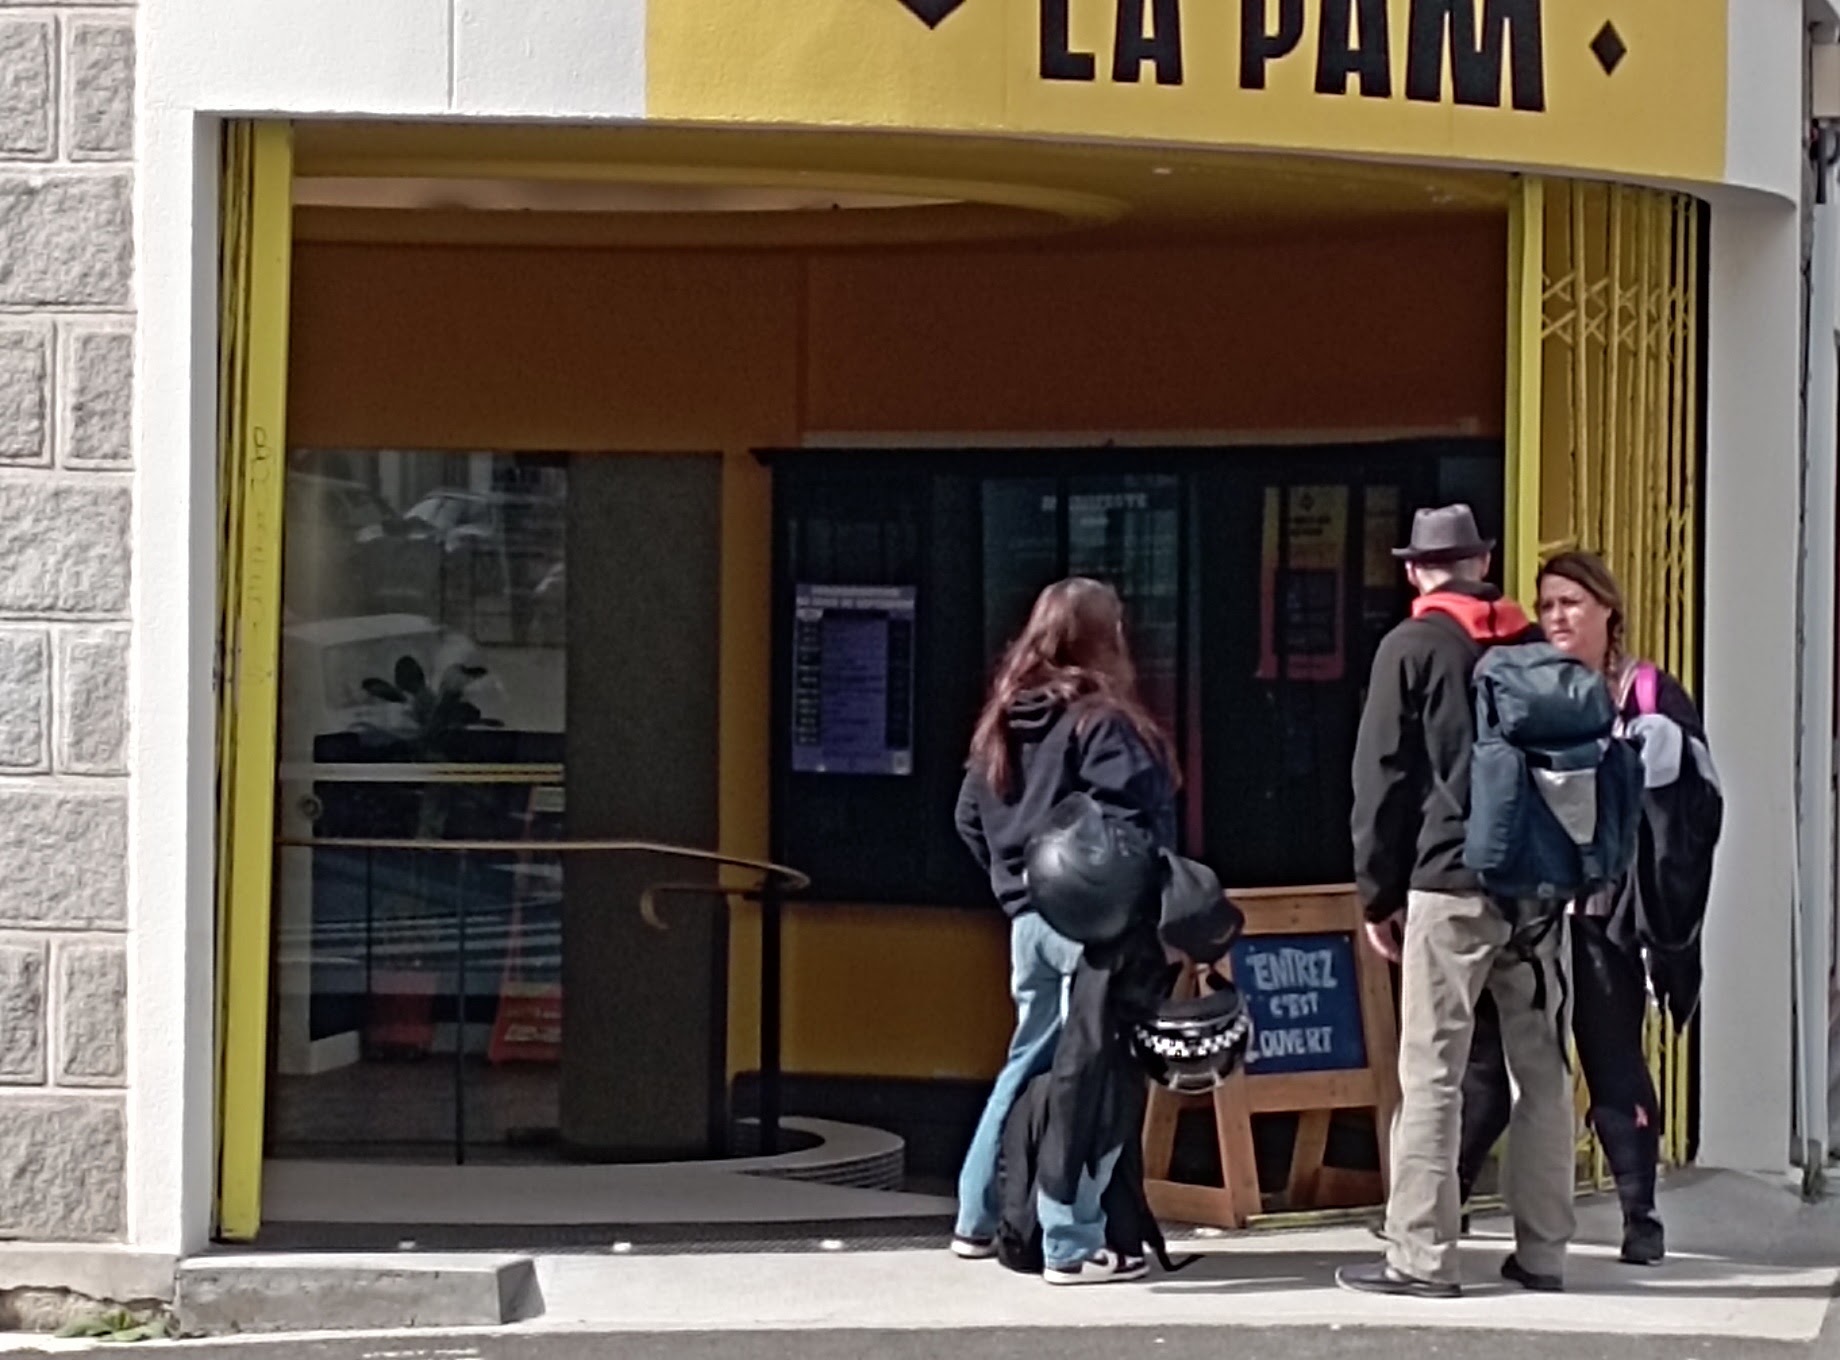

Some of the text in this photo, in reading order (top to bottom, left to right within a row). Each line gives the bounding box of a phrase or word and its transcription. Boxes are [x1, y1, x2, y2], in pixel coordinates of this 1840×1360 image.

[1245, 947, 1338, 991] ENTREZ
[1269, 991, 1319, 1019] C'EST
[1259, 1026, 1333, 1058] OUVERT
